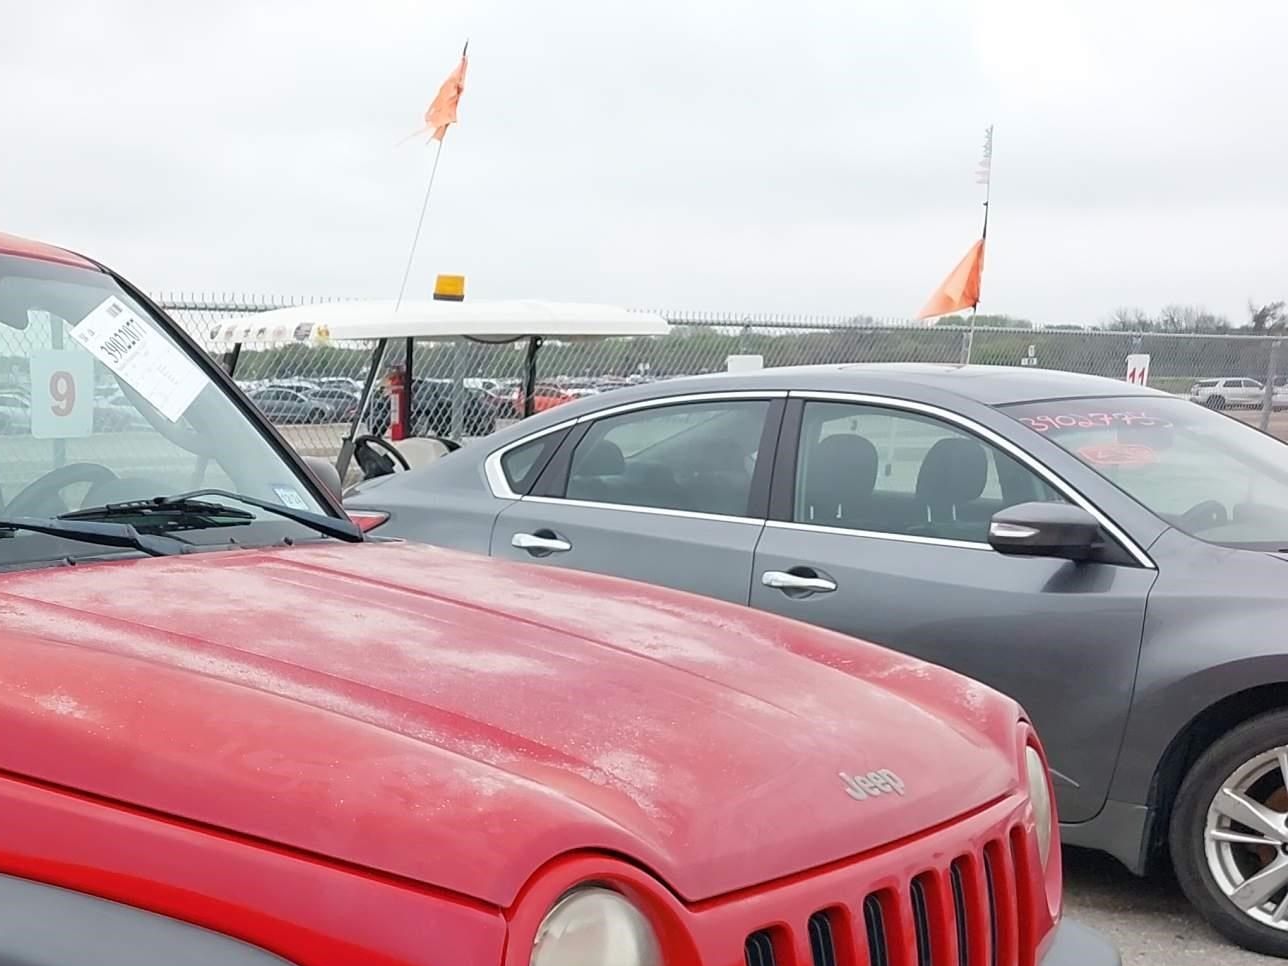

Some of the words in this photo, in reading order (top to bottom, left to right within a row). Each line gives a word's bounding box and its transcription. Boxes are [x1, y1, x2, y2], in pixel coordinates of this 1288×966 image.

[100, 318, 148, 363] 39022077
[49, 370, 76, 417] 9
[1128, 367, 1146, 385] 11
[838, 768, 905, 801] Jeep
